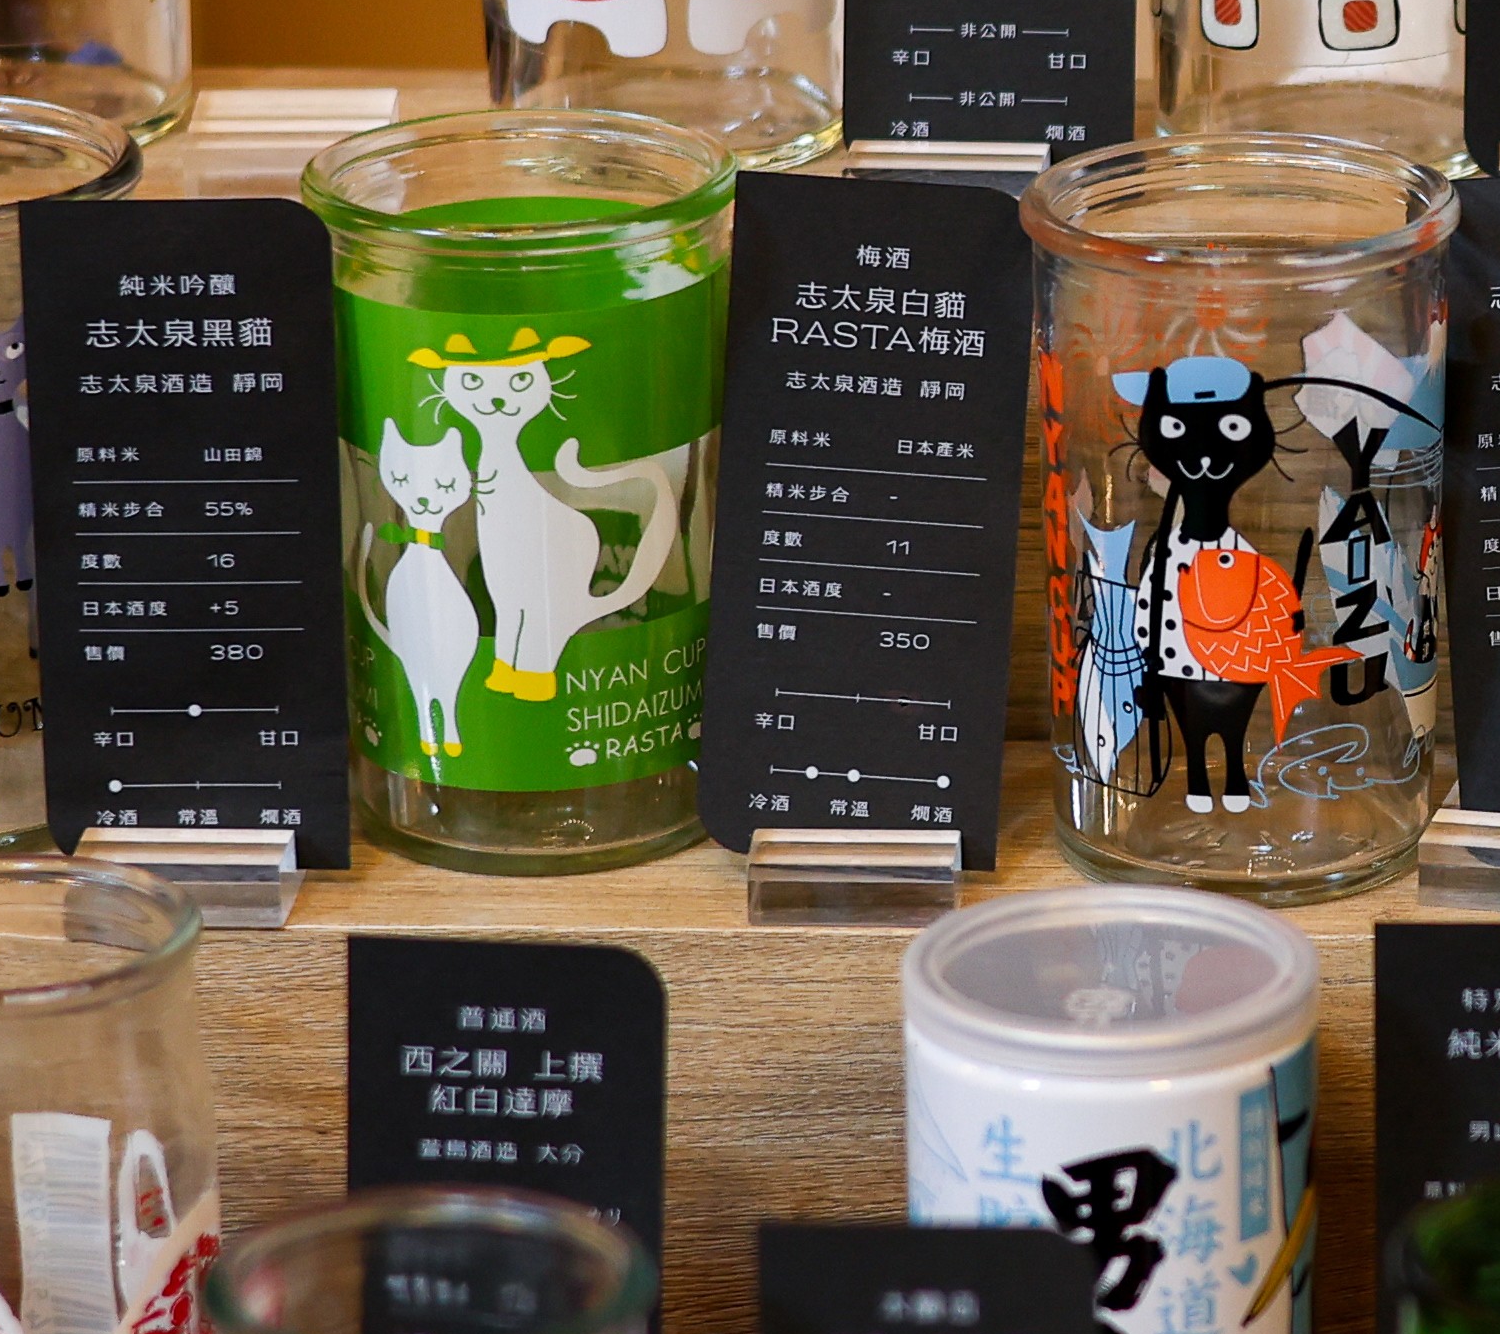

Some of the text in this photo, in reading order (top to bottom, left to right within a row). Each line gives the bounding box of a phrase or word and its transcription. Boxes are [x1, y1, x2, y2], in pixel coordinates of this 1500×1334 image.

[893, 50, 1086, 69] 辛口 甘口
[857, 245, 910, 269] 梅酒
[796, 282, 966, 319] 志太泉白貓
[87, 318, 272, 347] 志太泉黑貓
[771, 318, 985, 357] RASTA梅酒
[81, 374, 212, 393] 志太泉酒造
[786, 371, 902, 396] 志太泉酒造
[769, 429, 830, 447] 原料米
[211, 645, 263, 660] 380
[880, 632, 929, 649] 350
[566, 637, 707, 694] NYAN CUP
[606, 722, 684, 758] RASTA
